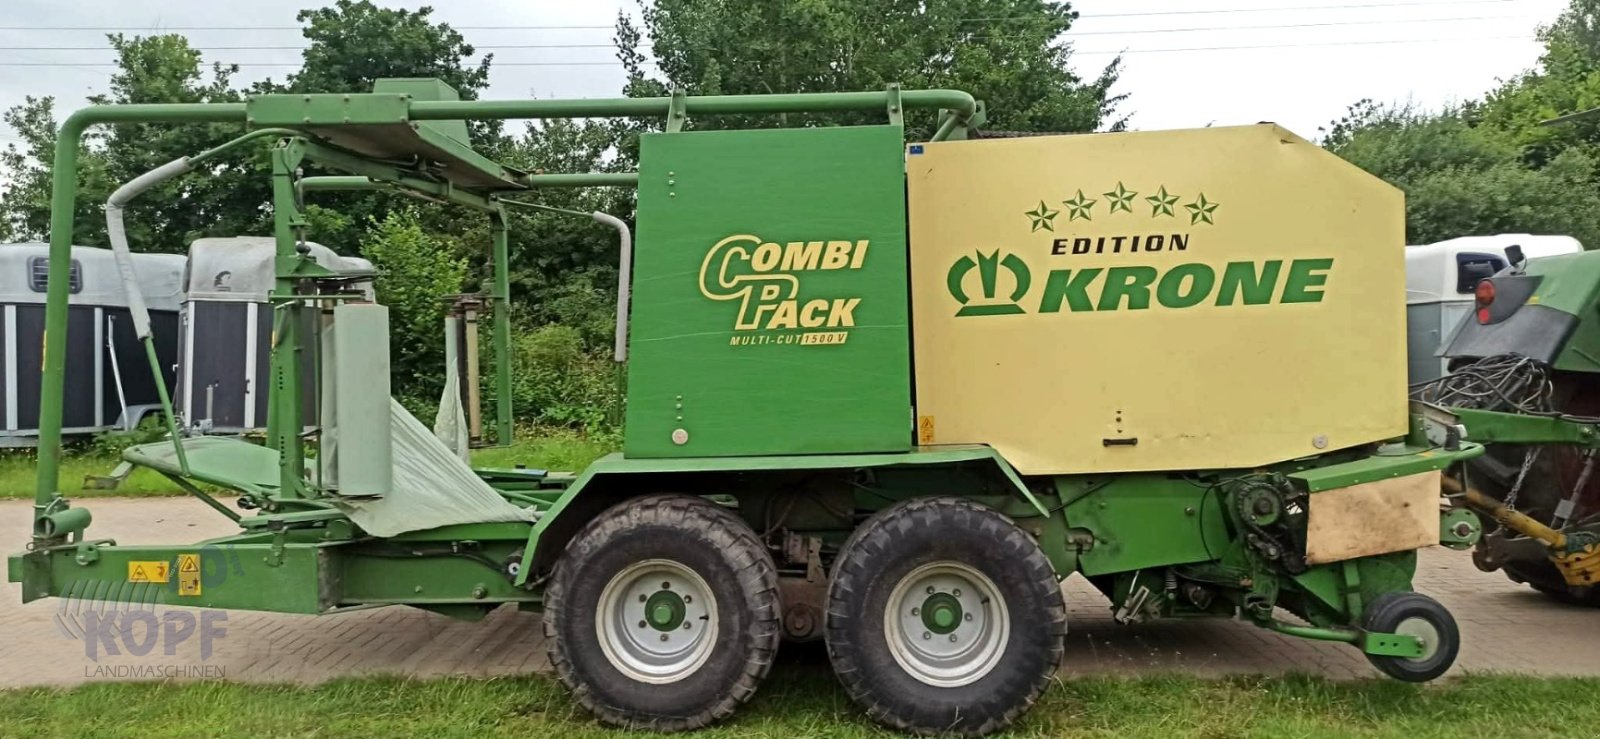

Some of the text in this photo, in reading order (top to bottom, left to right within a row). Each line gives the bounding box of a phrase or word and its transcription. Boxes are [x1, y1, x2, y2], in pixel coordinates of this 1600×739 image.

[699, 234, 869, 300] COMBI
[1051, 233, 1190, 255] EDITION
[735, 274, 862, 330] PACK
[1038, 258, 1334, 314] KRONE
[729, 335, 801, 346] MULTI-CUT
[803, 334, 833, 344] 1500
